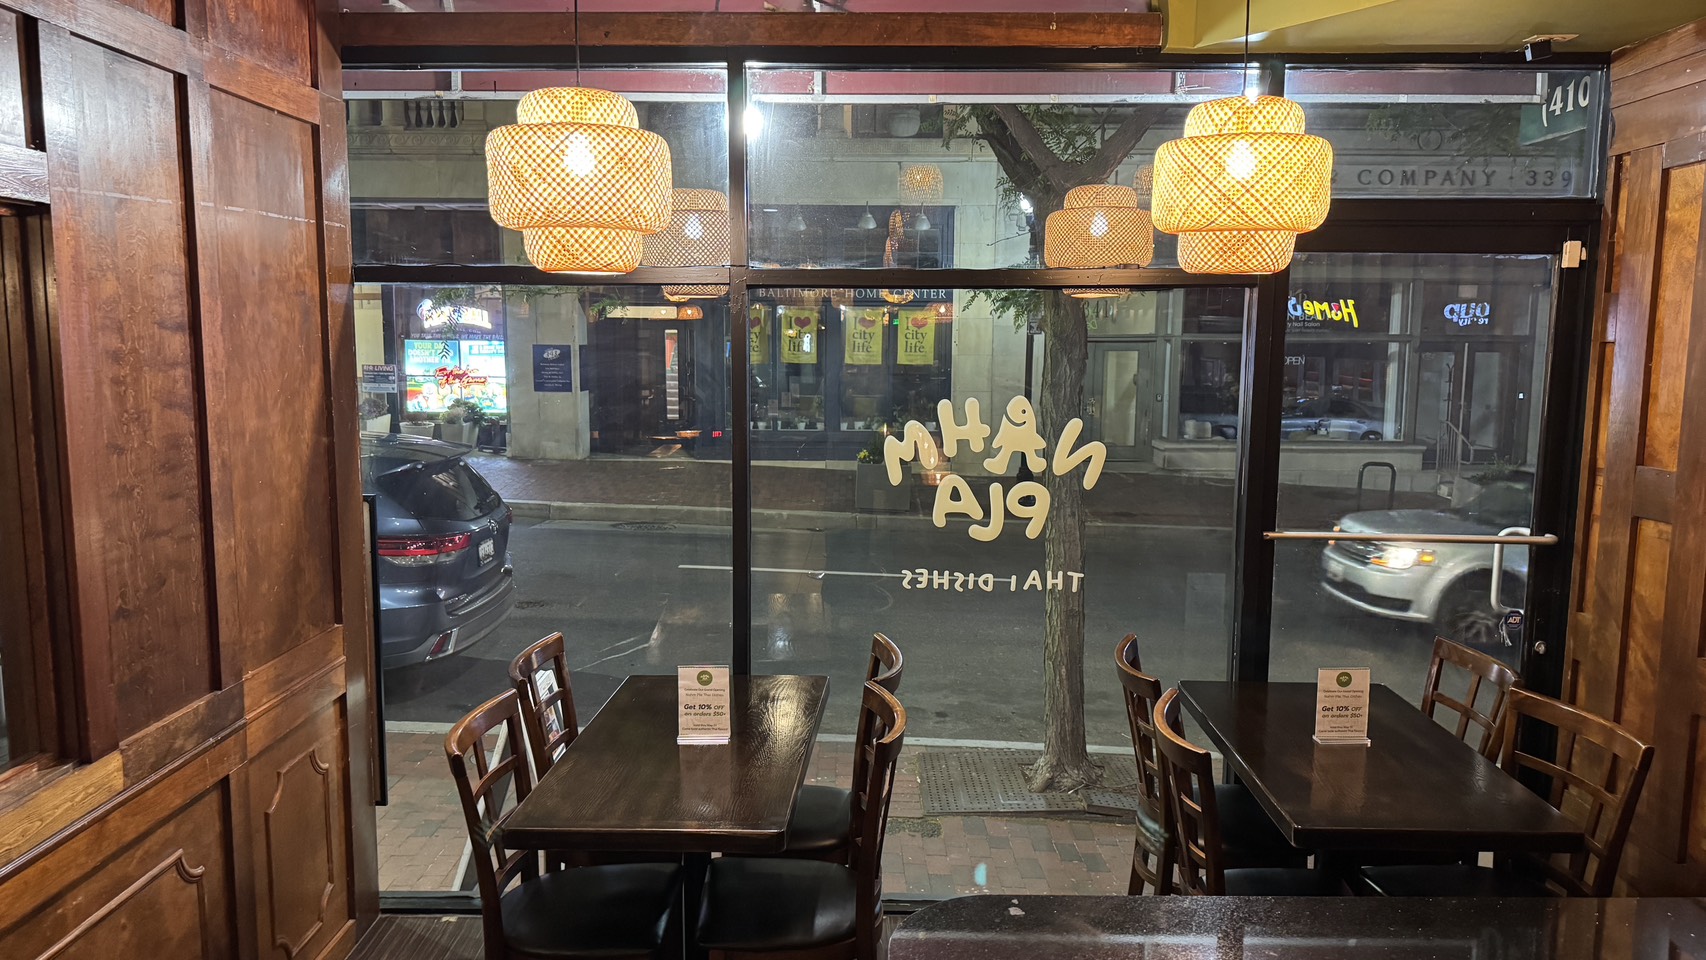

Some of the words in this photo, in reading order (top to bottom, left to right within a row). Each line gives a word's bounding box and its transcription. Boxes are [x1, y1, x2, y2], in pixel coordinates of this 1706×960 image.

[1357, 168, 1496, 187] COMPANY
[1525, 170, 1573, 188] 339
[759, 288, 837, 298] BALTIMORE
[893, 288, 946, 298] CENTER
[852, 329, 875, 344] city
[904, 329, 928, 344] city
[853, 341, 872, 353] life
[904, 341, 925, 353] life
[1507, 616, 1521, 624] ADT
